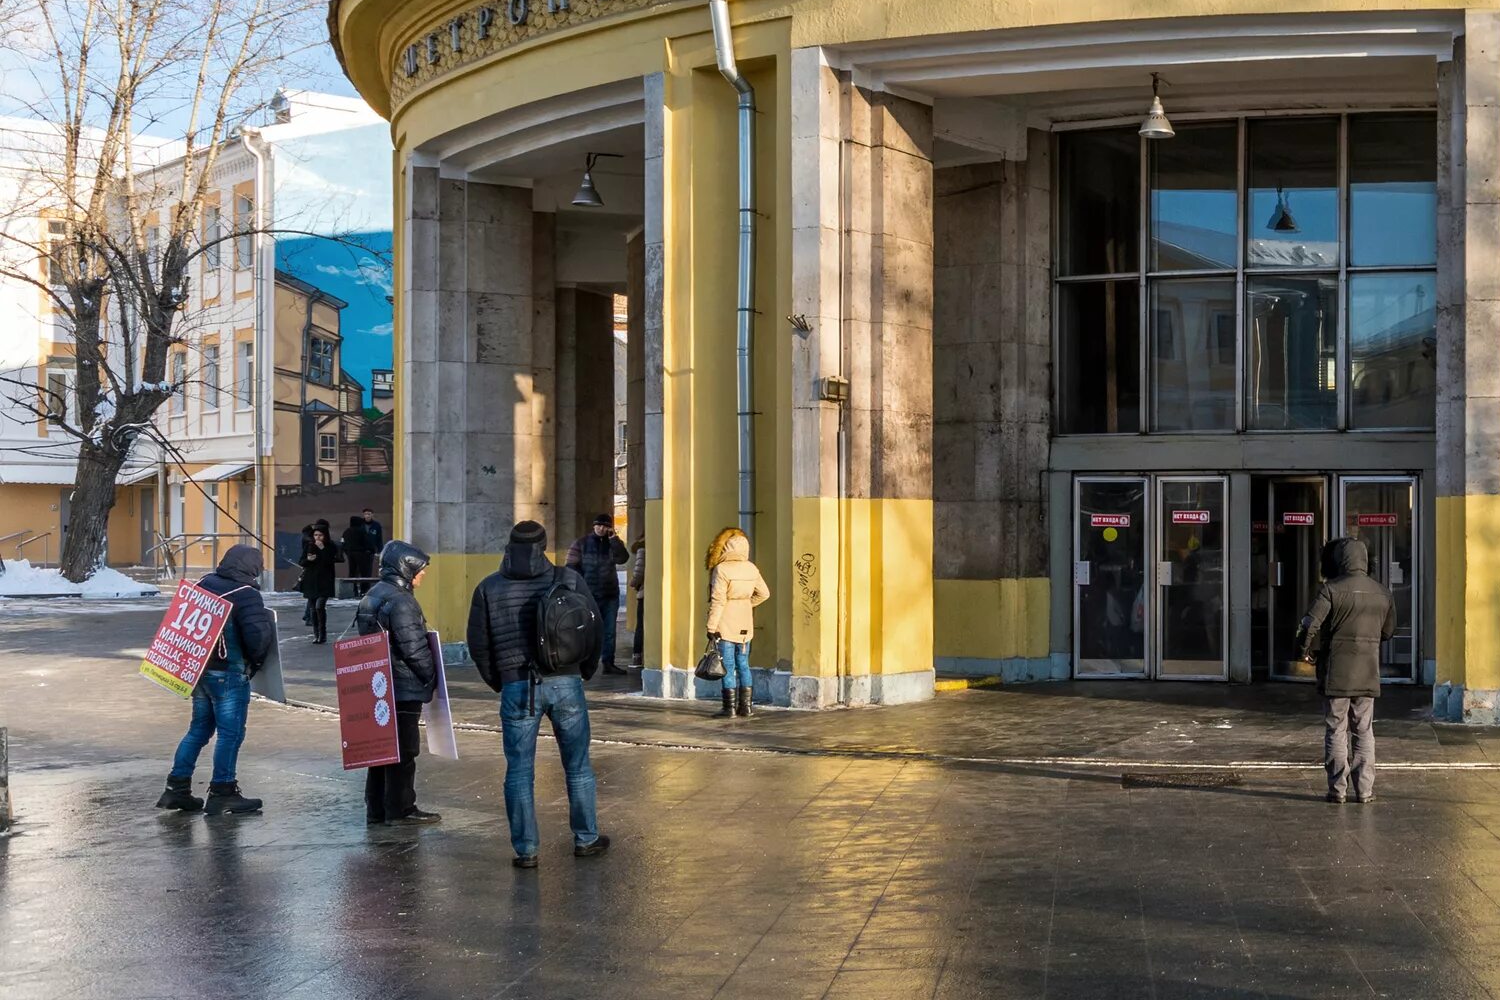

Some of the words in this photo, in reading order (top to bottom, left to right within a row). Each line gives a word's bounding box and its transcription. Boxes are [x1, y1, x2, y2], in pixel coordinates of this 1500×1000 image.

[178, 584, 226, 619] СТРИЖКА
[170, 601, 213, 641] 149
[151, 639, 184, 663] SHELLAC
[185, 657, 200, 672] 550
[158, 626, 208, 659] МАНИКЮР
[146, 650, 180, 675] ПЕДИКЮР
[180, 669, 195, 683] 600
